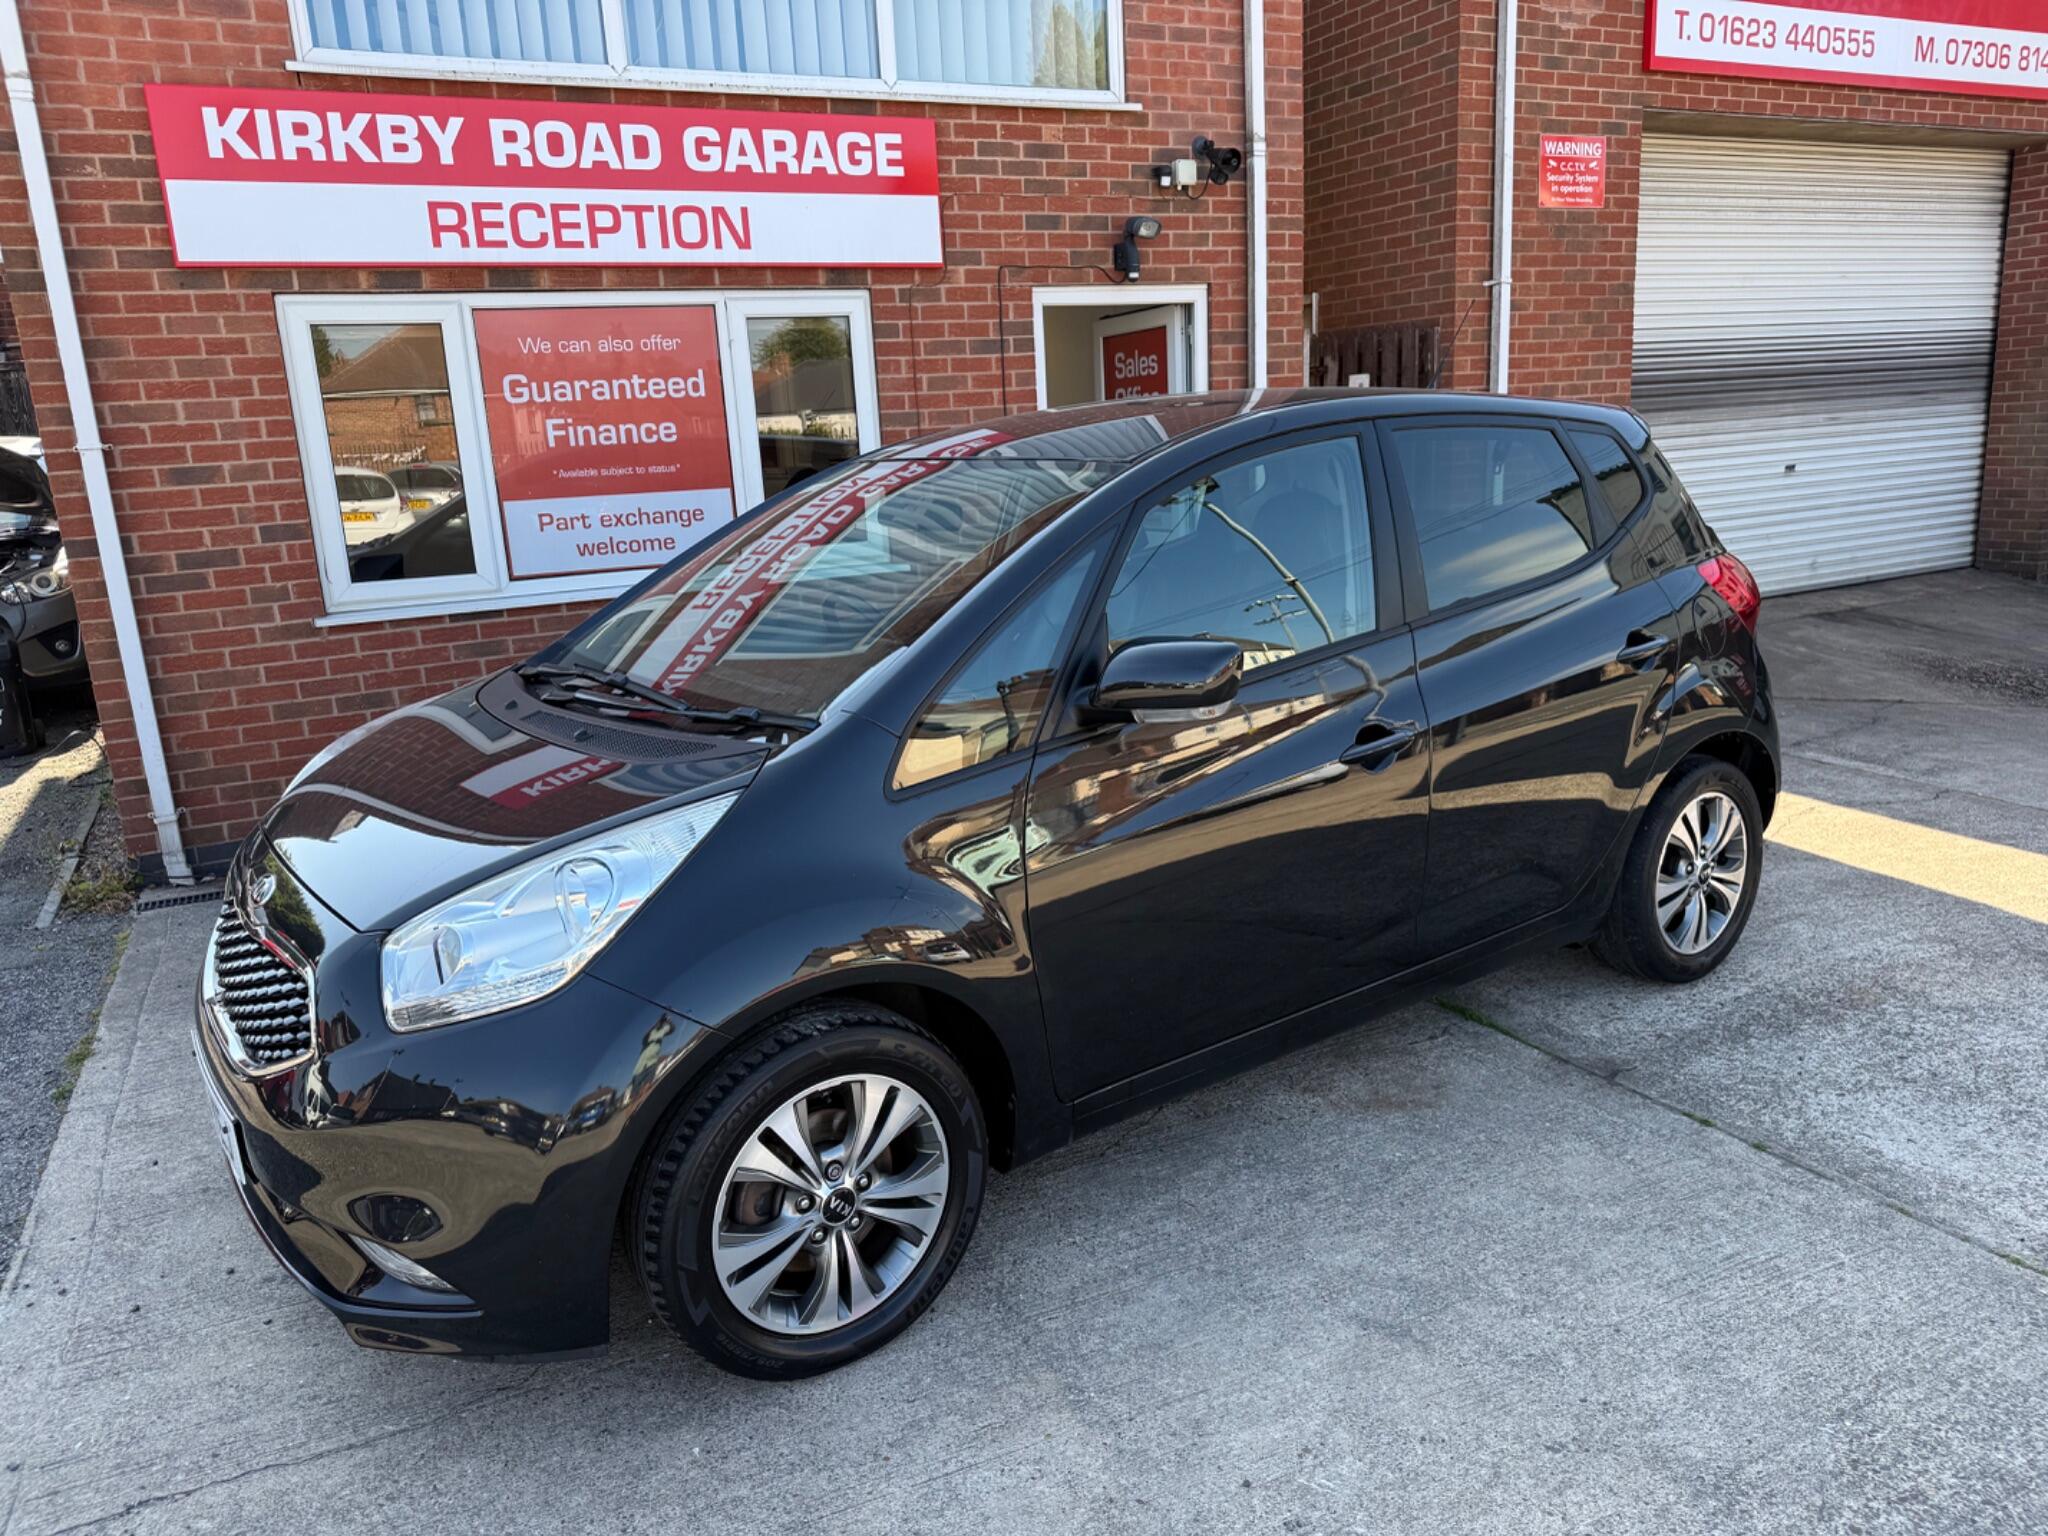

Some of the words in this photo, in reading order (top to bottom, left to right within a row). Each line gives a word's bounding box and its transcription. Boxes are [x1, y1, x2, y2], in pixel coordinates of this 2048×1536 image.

[1674, 9, 1692, 41] T.
[1699, 12, 1777, 49] 01623
[1785, 22, 1876, 58] 440555
[1914, 35, 1939, 65] M.
[1945, 38, 2011, 70] 07306
[200, 106, 465, 166] KIRKBY
[489, 118, 662, 171] ROAD
[682, 126, 906, 178] GARAGE
[1544, 140, 1603, 156] WARNING
[1546, 172, 1574, 184] Security
[1575, 173, 1599, 184] System
[1551, 183, 1559, 192] in
[1560, 185, 1593, 195] operation
[427, 200, 753, 251] RECEPTION
[517, 337, 552, 354] We
[558, 339, 592, 353] can
[598, 335, 634, 353] also
[640, 334, 681, 351] offer
[1114, 349, 1159, 379] Sales
[502, 369, 706, 404] Guaranteed
[545, 418, 678, 449] Finance
[636, 466, 646, 474] to
[537, 512, 592, 533] Part
[600, 507, 705, 529] exchange
[576, 536, 676, 557] welcome
